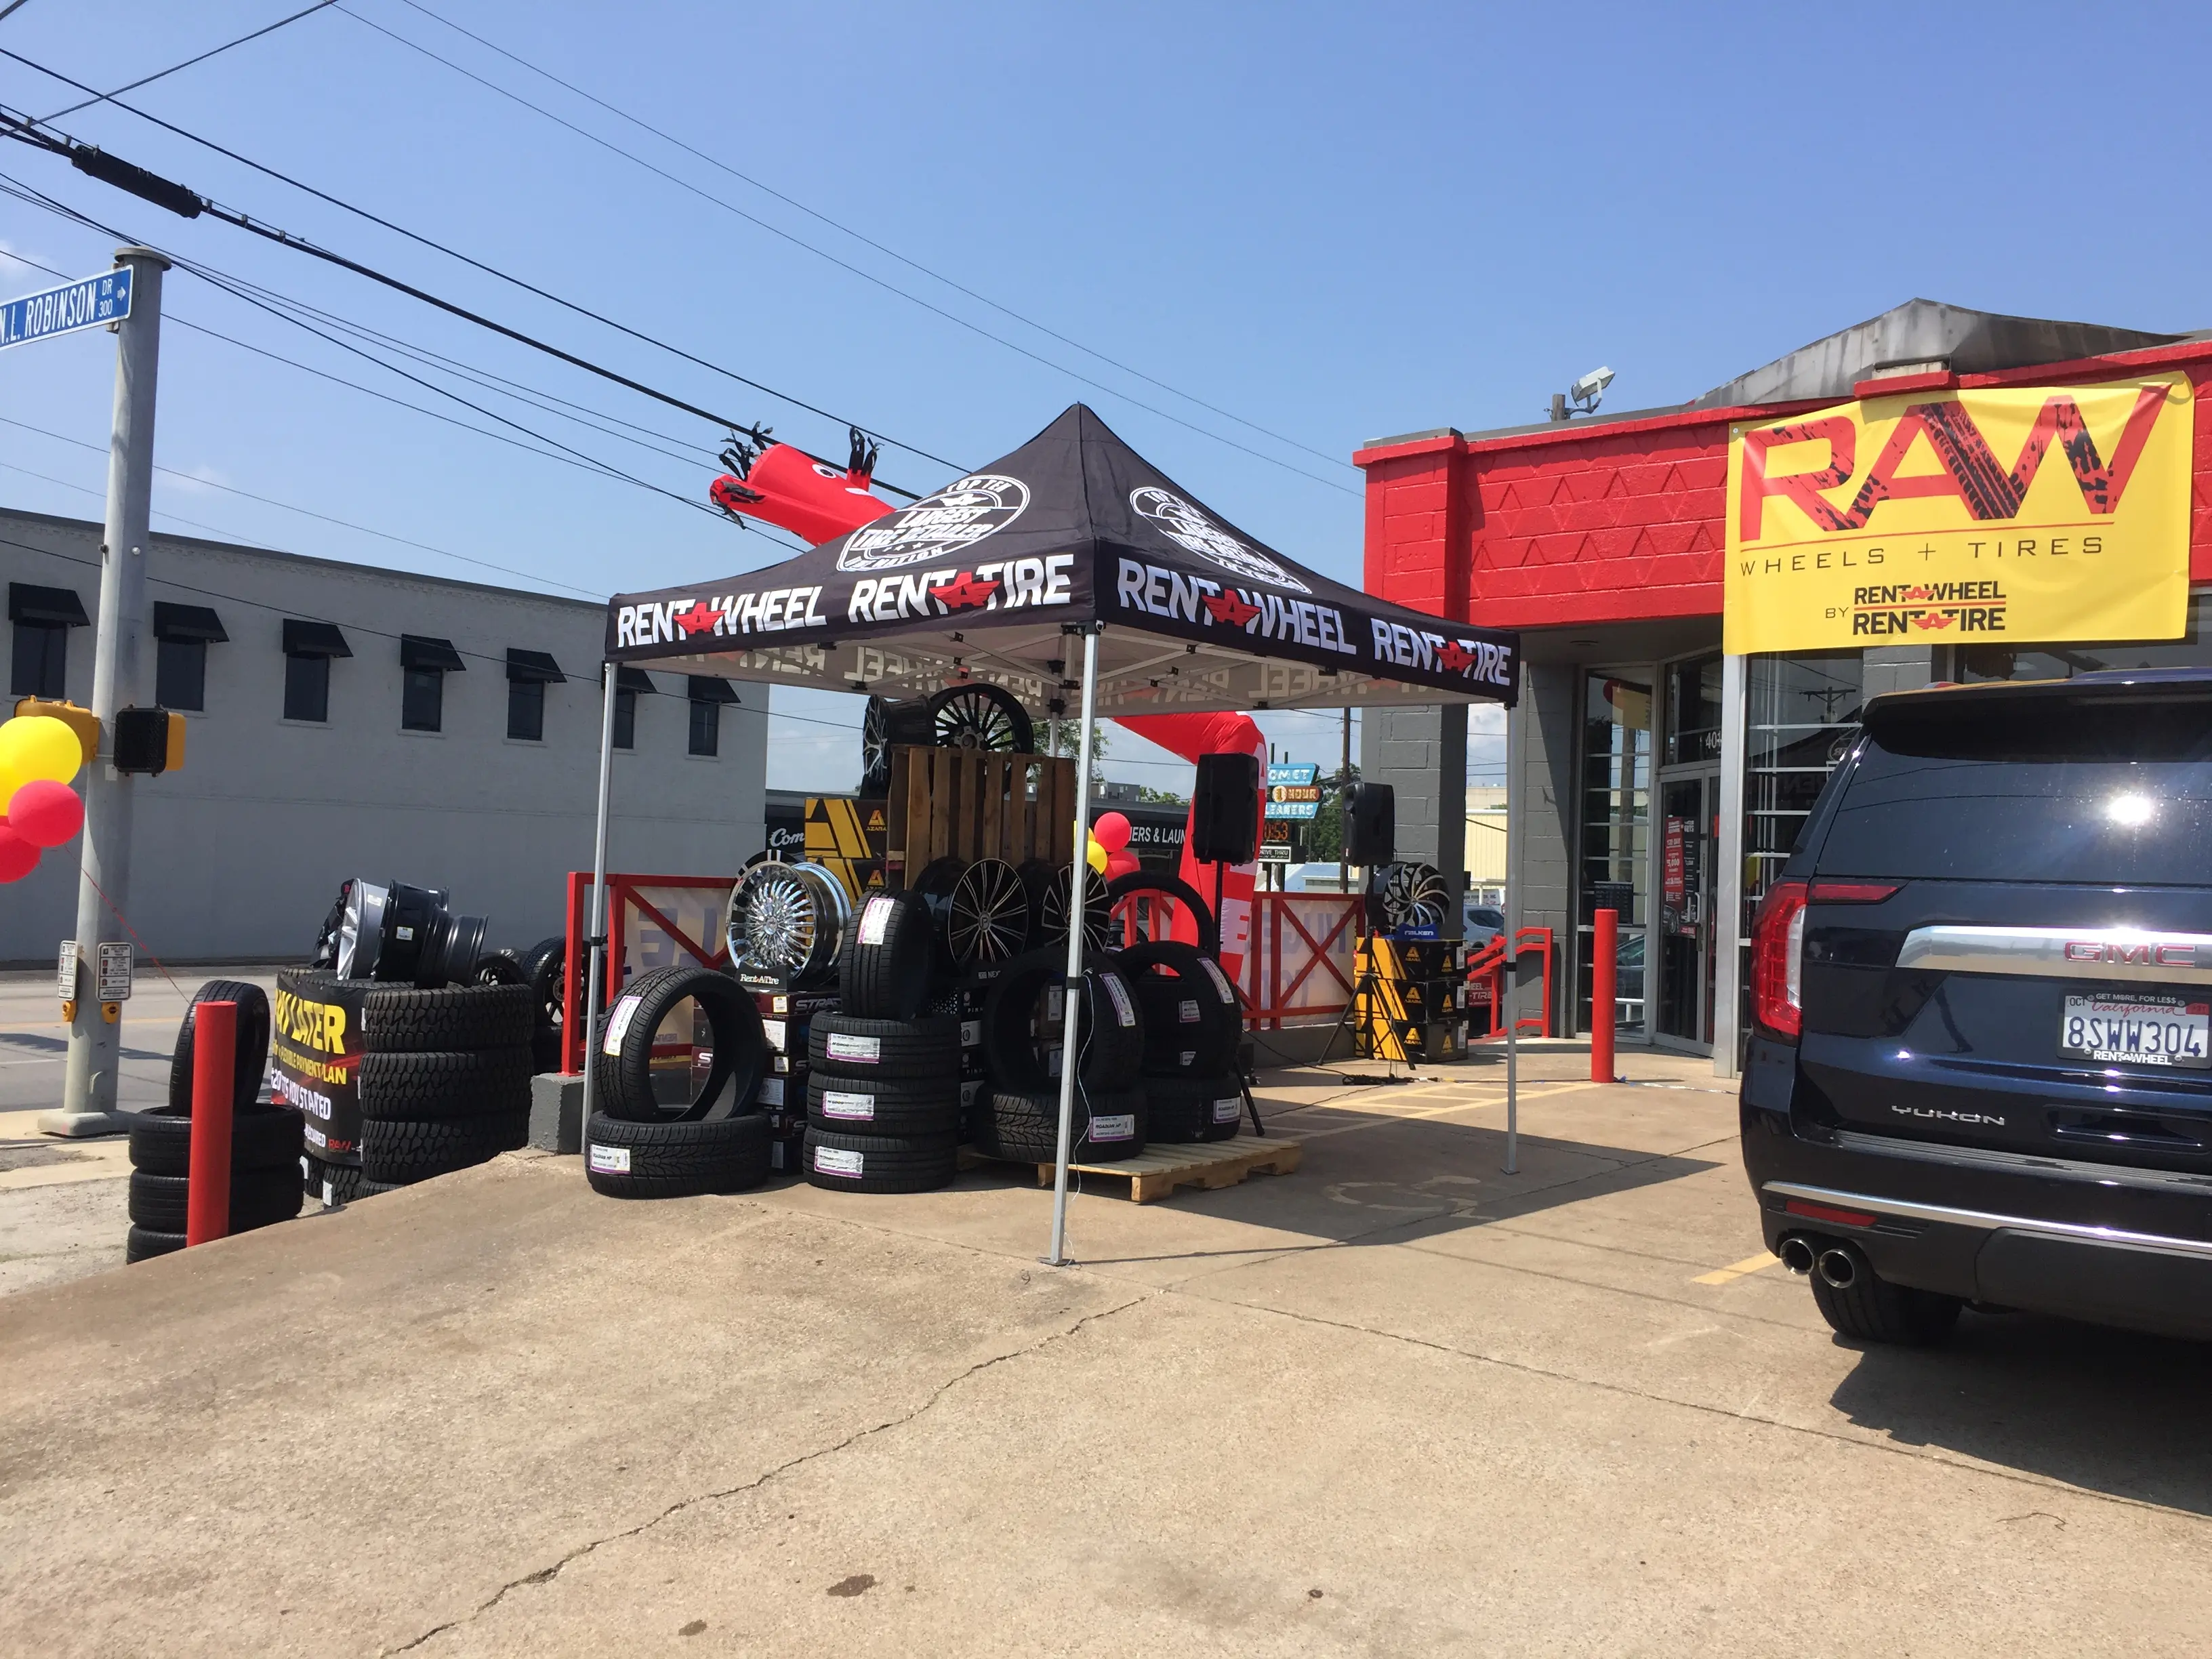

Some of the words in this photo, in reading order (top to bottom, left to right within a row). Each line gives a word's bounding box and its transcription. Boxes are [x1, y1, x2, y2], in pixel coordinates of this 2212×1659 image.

[24, 281, 97, 337] ROBINSON
[102, 279, 112, 296] DR
[98, 299, 112, 318] 300
[1740, 382, 2173, 543] RAW
[1740, 548, 1885, 576] WHEELS
[1967, 537, 2103, 559] TIRES
[1825, 607, 1849, 619] BY
[1267, 767, 1310, 781] OMET
[1288, 788, 1317, 800] HOUR
[1265, 804, 1313, 815] LEANERS
[1130, 826, 1151, 842] ERS
[1153, 827, 1160, 843] &
[2063, 941, 2198, 968] GMC
[2139, 995, 2155, 1003] FOR
[2091, 1002, 2186, 1018] California
[291, 995, 346, 1054] LATER
[2068, 1016, 2201, 1057] 8SWW304
[1891, 1105, 2005, 1126] YUKON
